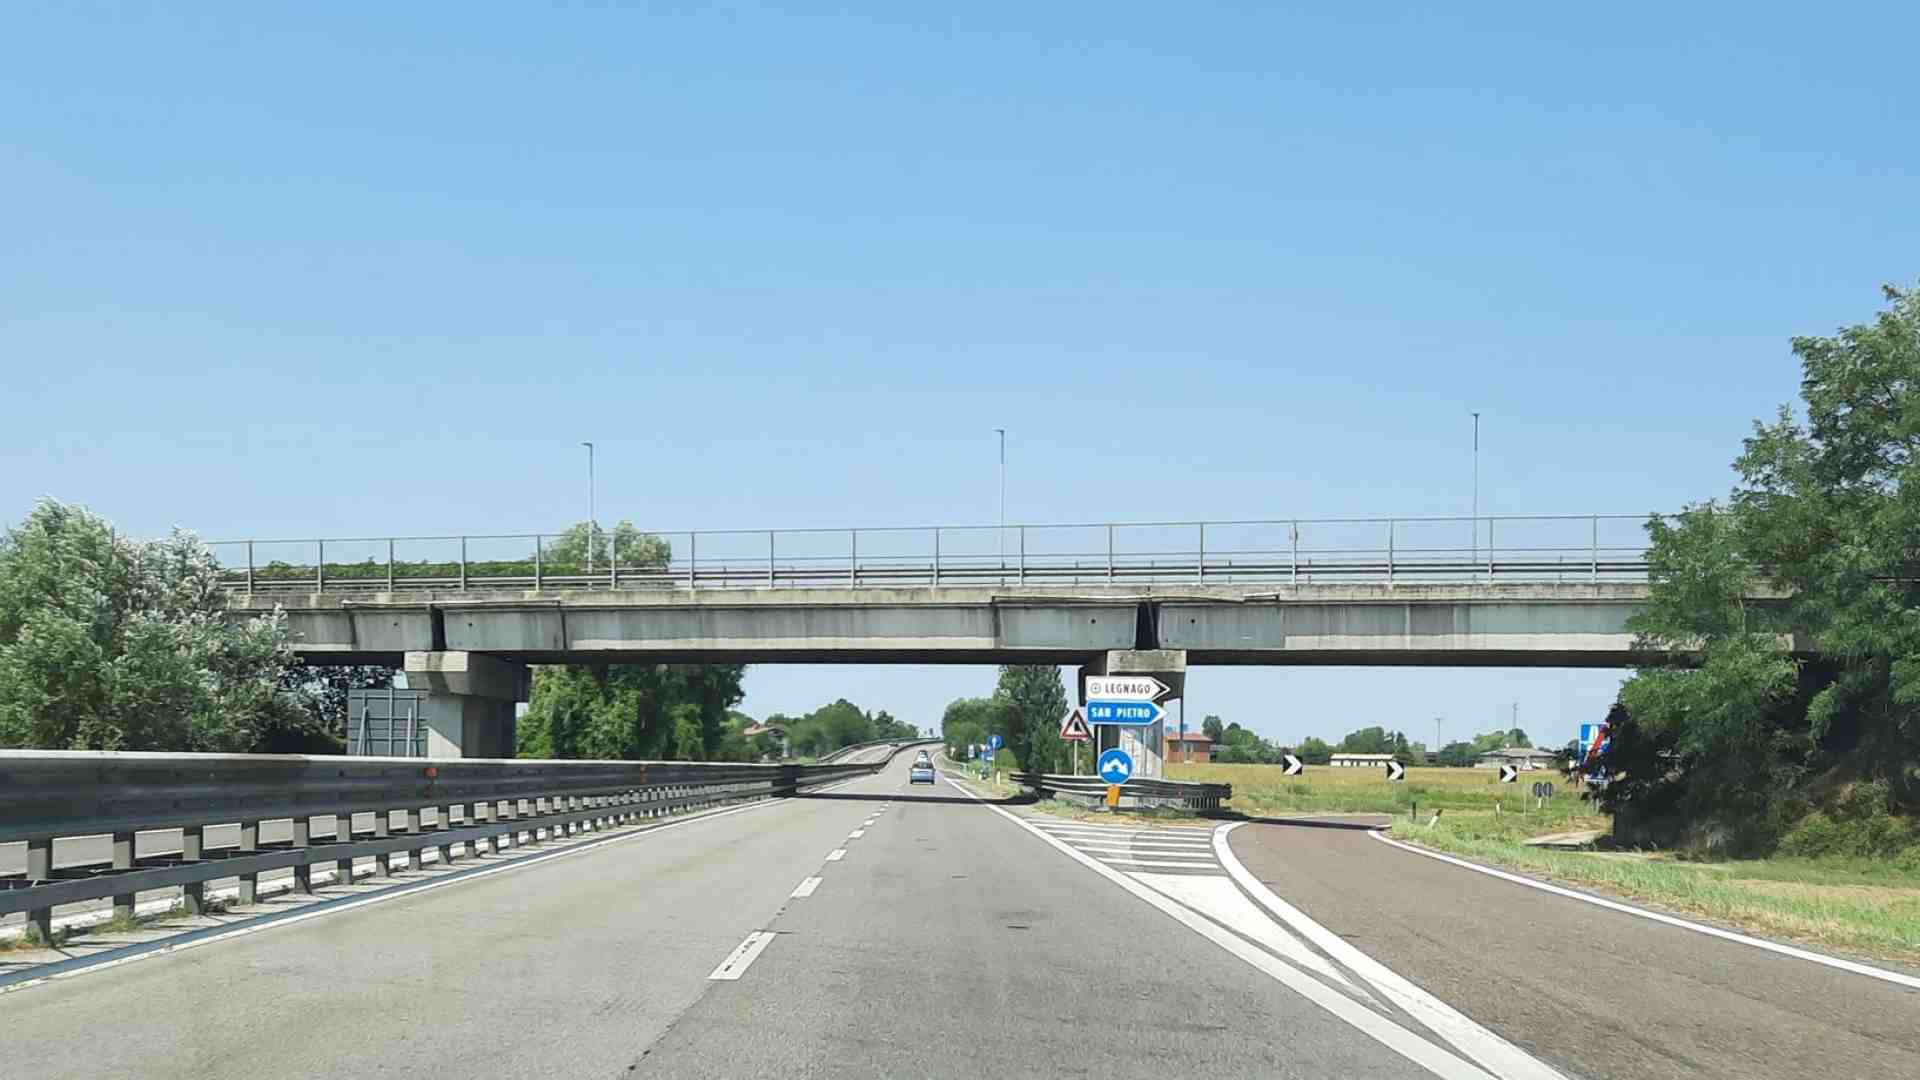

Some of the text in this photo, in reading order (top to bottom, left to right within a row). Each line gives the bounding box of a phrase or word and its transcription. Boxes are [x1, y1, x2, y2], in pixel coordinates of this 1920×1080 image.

[1104, 683, 1151, 694] LEGNAGO
[1091, 707, 1151, 718] SAN PIETRO
